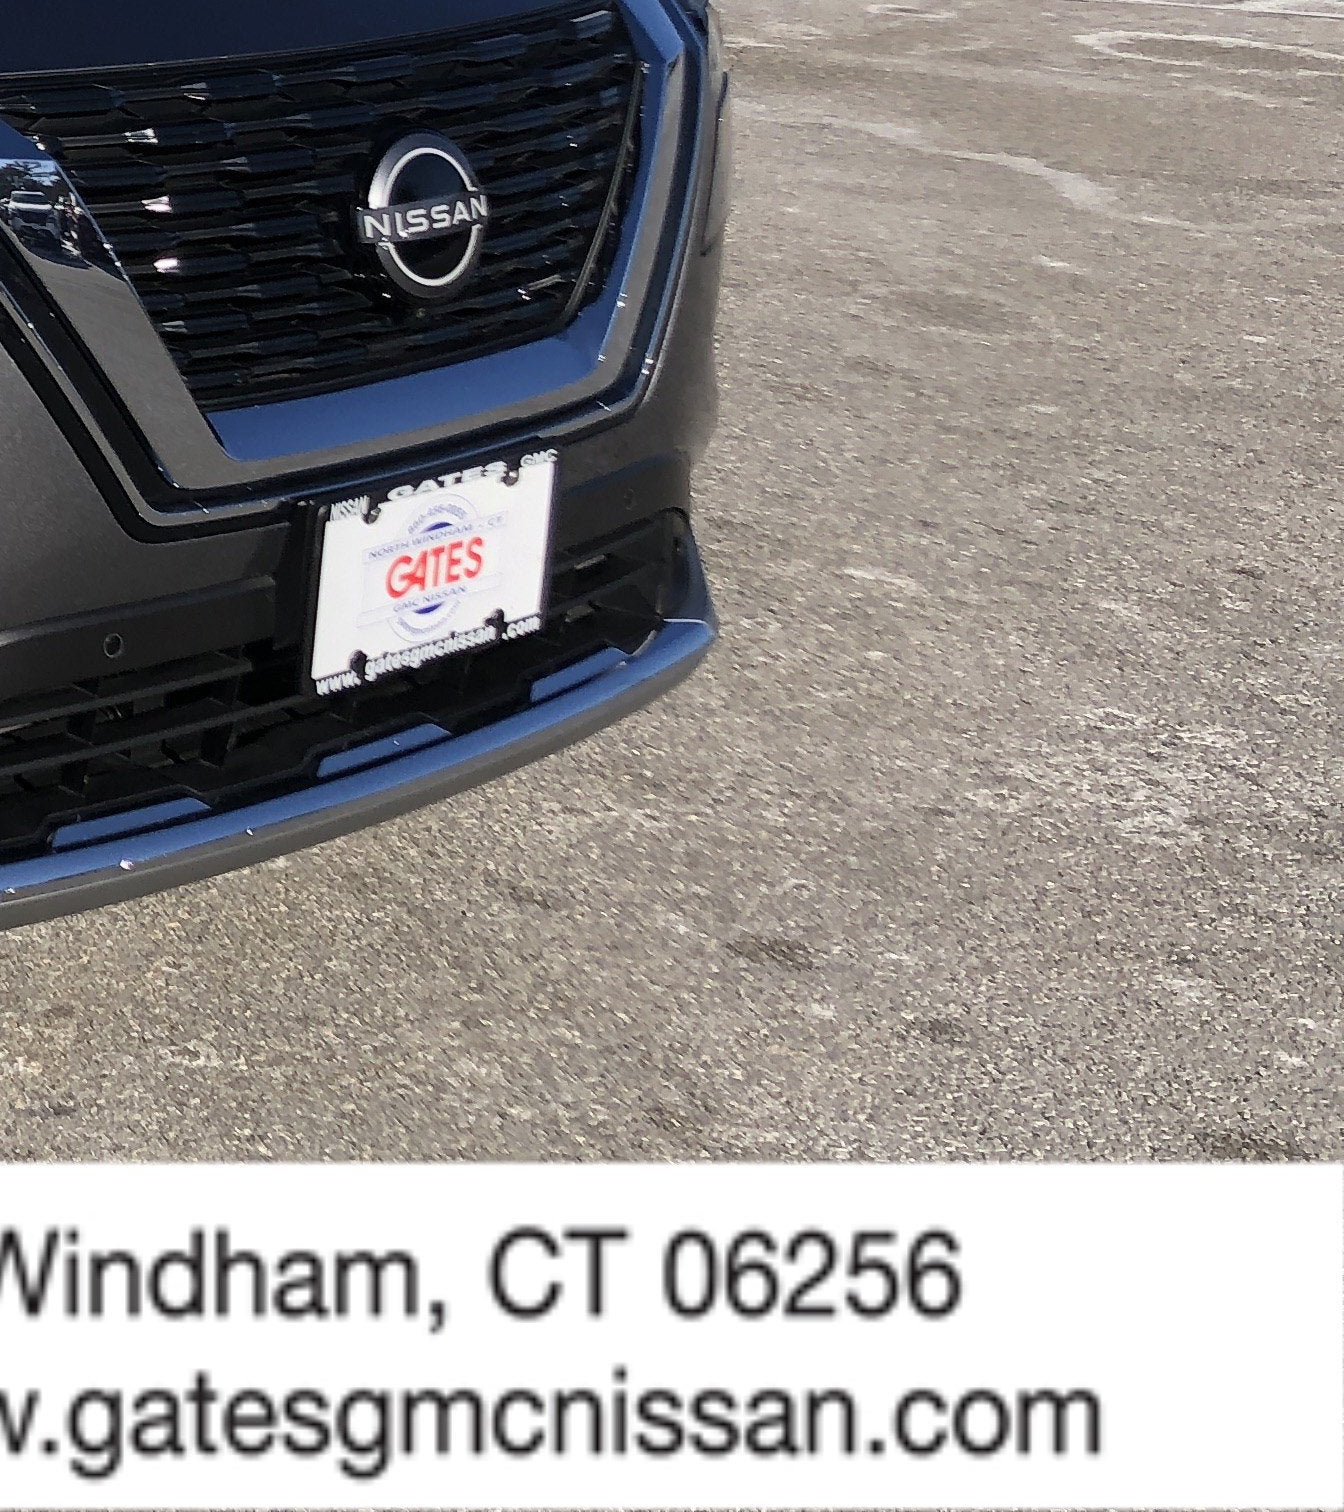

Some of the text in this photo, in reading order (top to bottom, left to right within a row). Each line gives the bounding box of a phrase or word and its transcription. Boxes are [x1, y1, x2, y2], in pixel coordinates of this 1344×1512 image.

[363, 194, 488, 239] NISSAN
[387, 461, 508, 501] GATES
[385, 536, 484, 600] GATES
